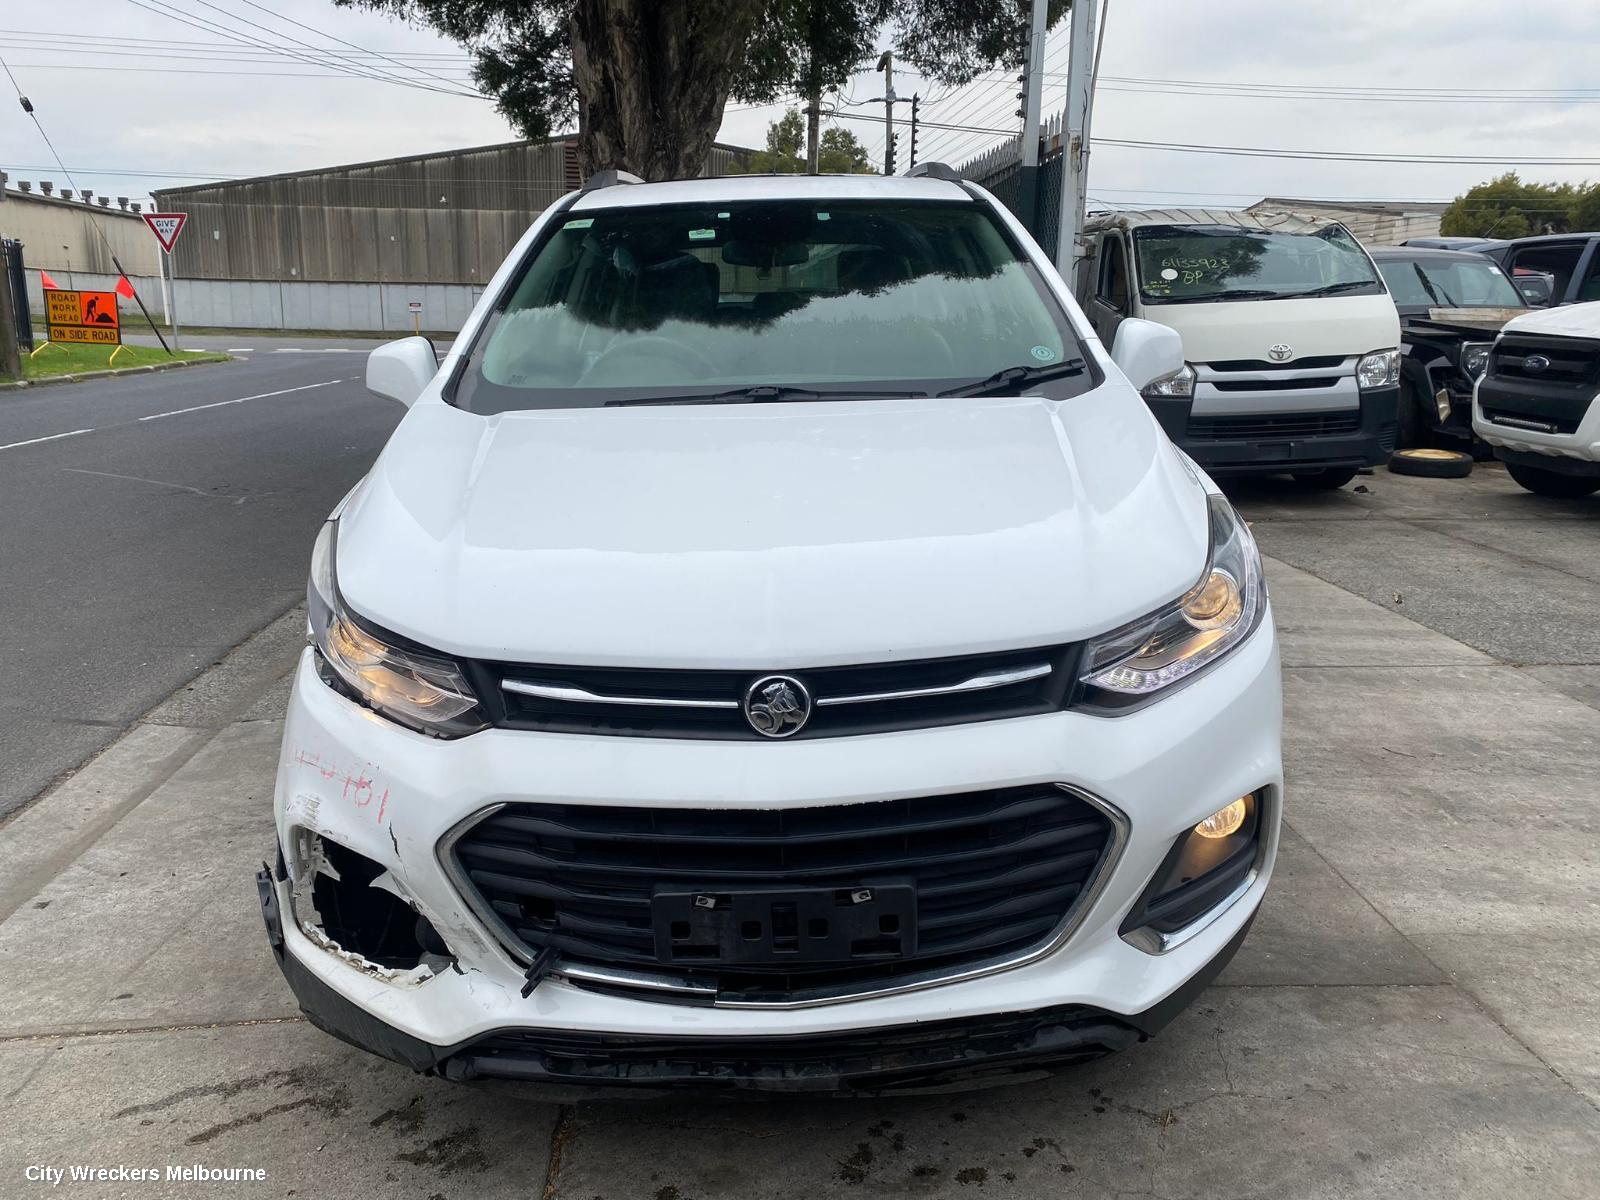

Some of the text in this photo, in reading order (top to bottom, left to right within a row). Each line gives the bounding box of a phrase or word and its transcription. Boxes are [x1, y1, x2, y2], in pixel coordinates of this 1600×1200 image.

[52, 304, 77, 312] WORK
[53, 314, 78, 322] AHEAD
[53, 329, 116, 341] ON SIDE ROAD
